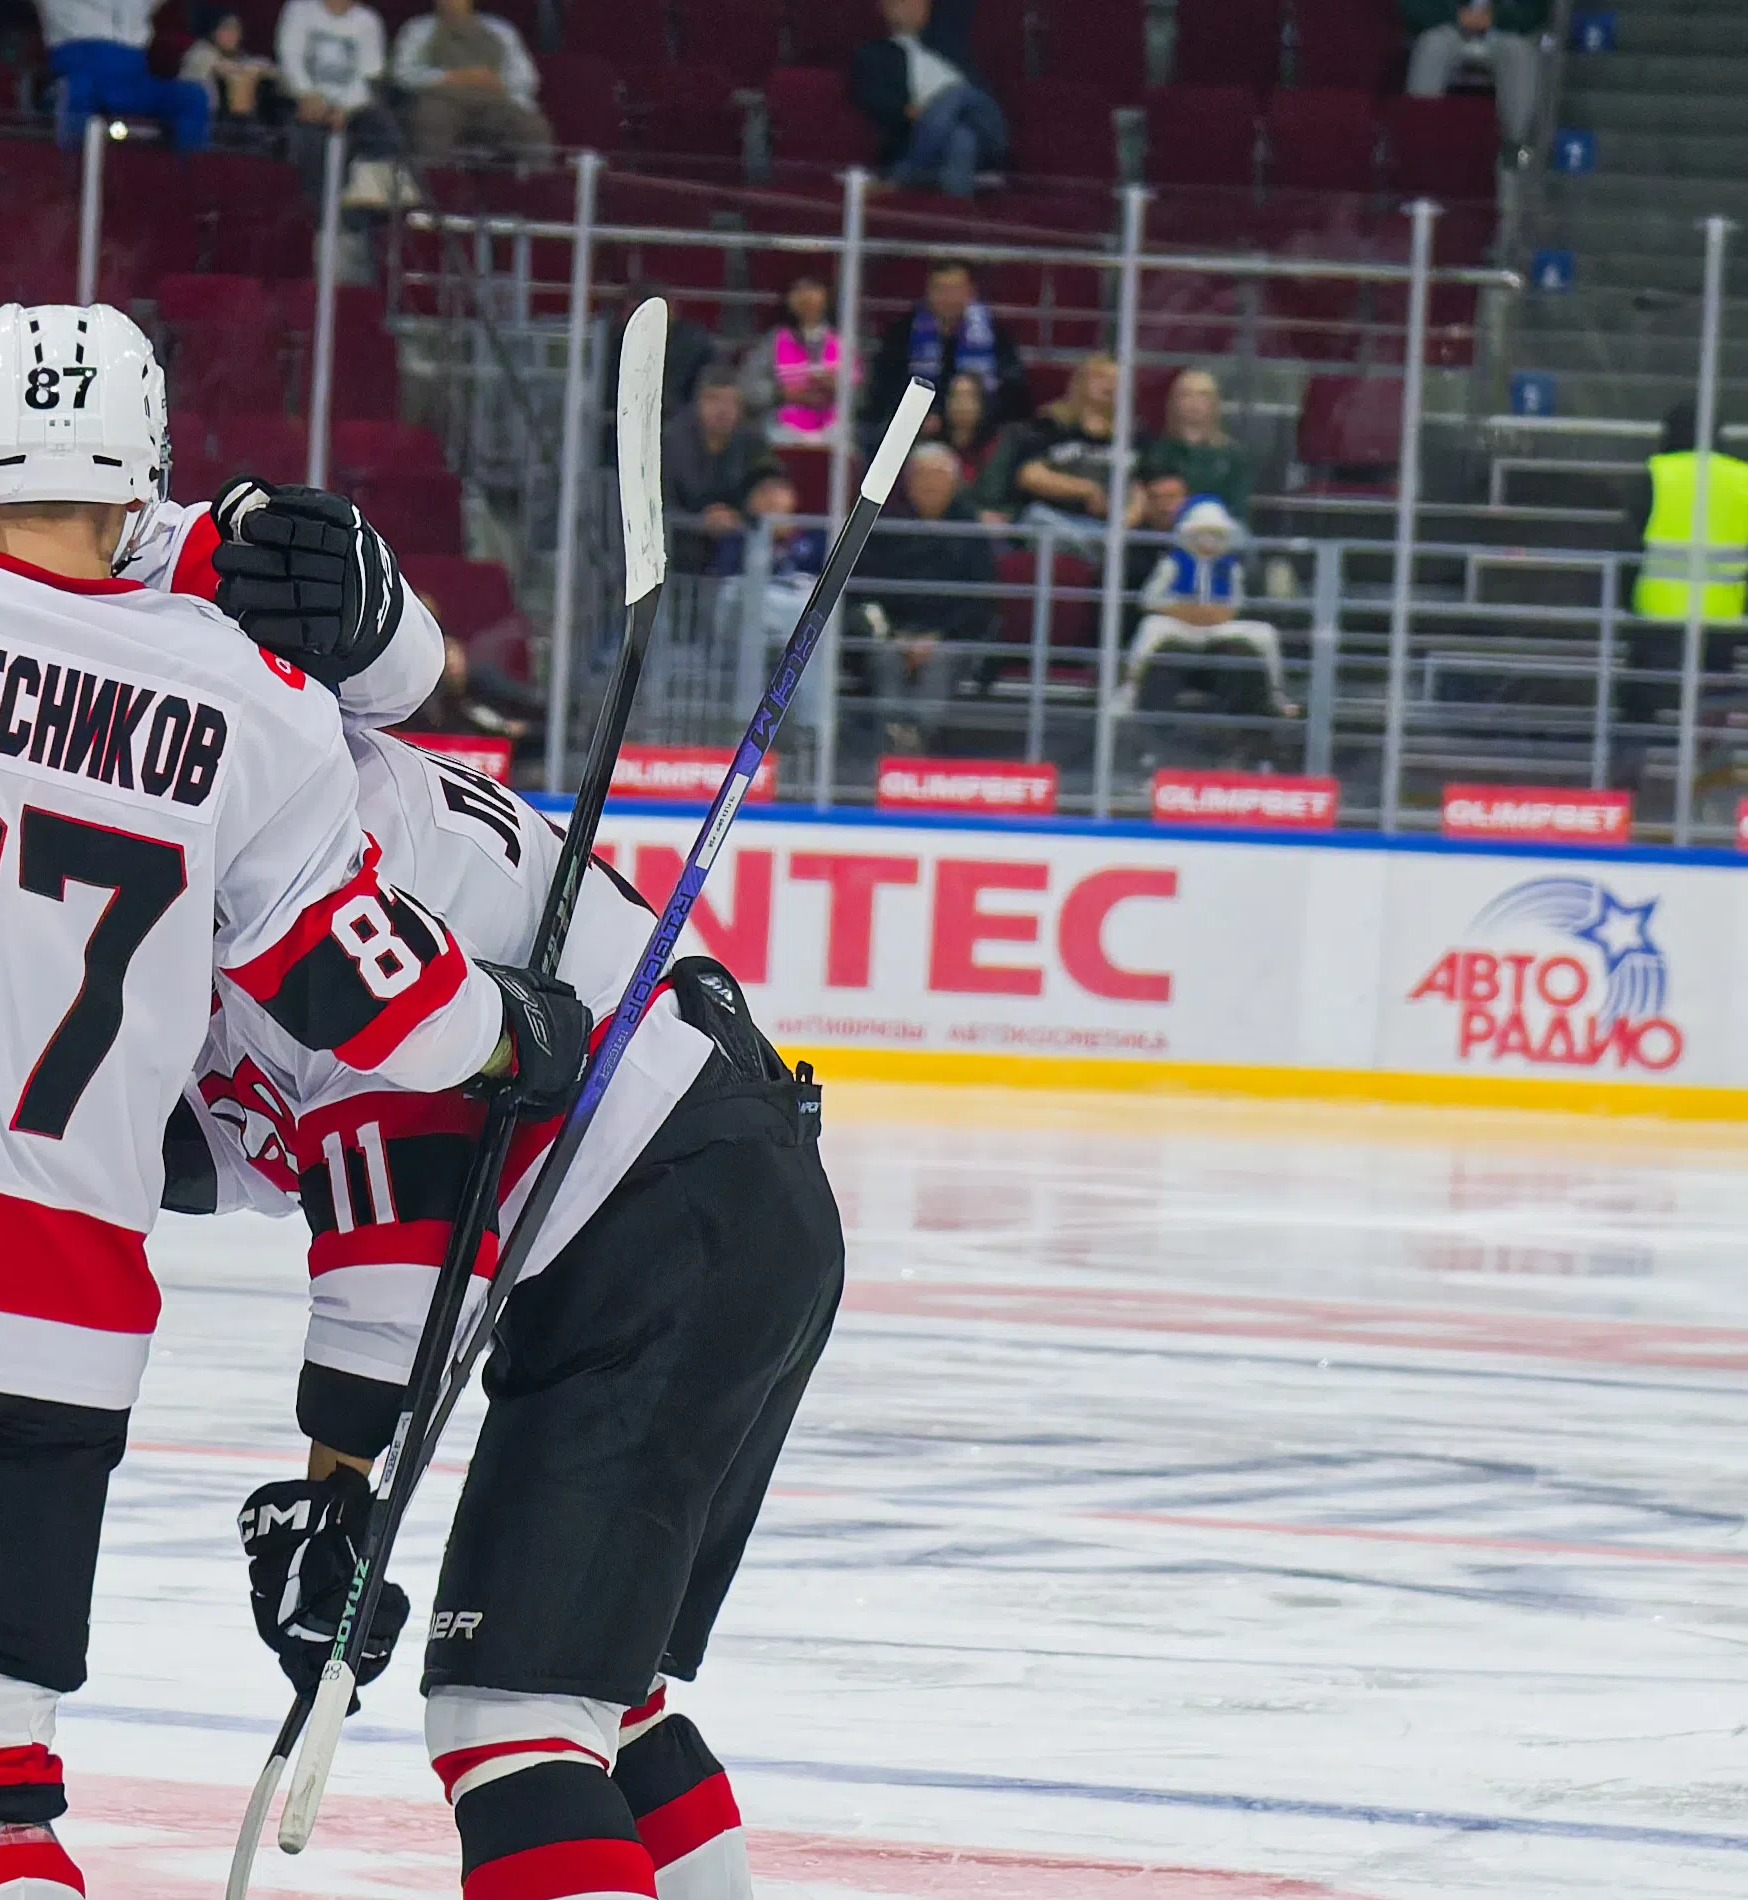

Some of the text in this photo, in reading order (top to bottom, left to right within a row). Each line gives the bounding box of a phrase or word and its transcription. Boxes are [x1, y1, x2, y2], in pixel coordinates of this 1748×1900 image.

[24, 366, 98, 410] 87
[879, 769, 1050, 801] OLIMPBET
[1155, 784, 1331, 819] OLIMPBET
[1444, 798, 1624, 832] OLIMPBET
[620, 892, 695, 1026] RIBCOR
[1406, 949, 1590, 1009] АВТО
[1458, 1008, 1684, 1071] РАДИО
[321, 1121, 398, 1233] 11
[330, 1556, 370, 1661] SOYUZ
